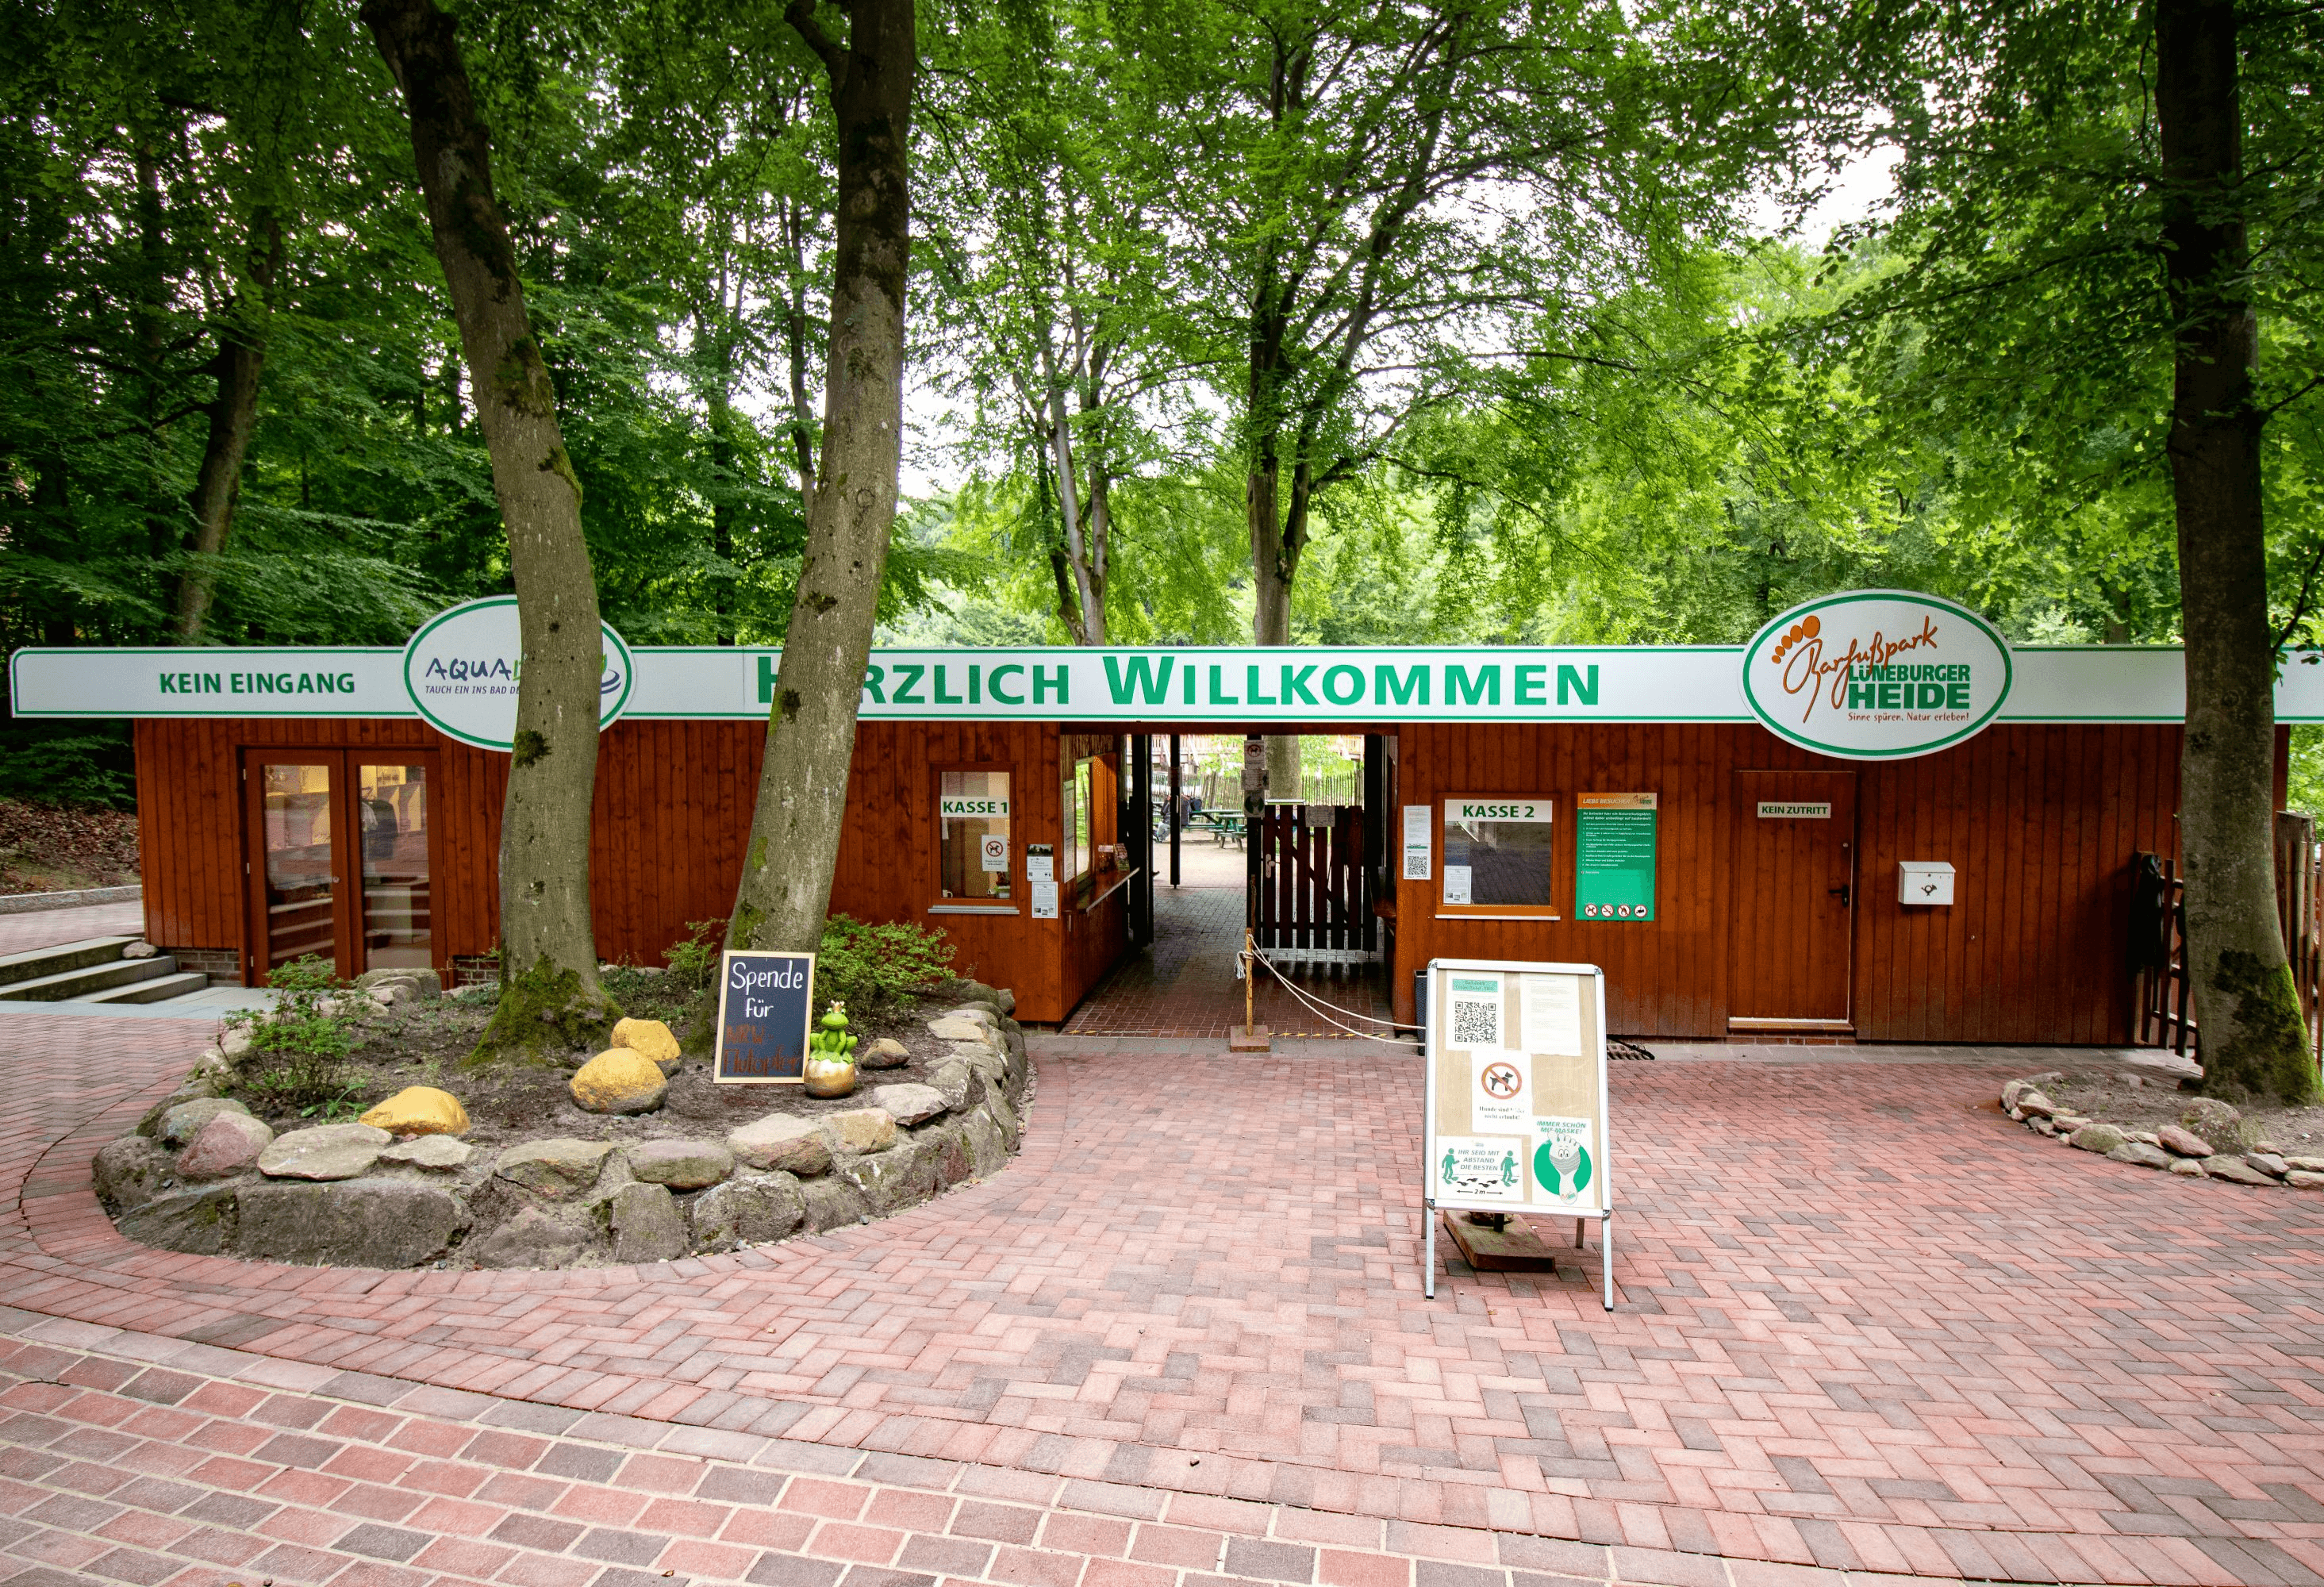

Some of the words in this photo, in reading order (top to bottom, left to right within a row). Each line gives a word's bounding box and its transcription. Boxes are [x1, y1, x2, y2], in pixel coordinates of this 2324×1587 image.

[425, 658, 521, 681] AQUA
[1783, 615, 1938, 723] Barfußpark
[1848, 664, 1971, 682] LÜNEBURGER
[159, 673, 221, 694] KEIN
[230, 673, 355, 694] EINGANG
[490, 686, 507, 694] BAD
[758, 656, 1068, 705] HRZLICH
[1102, 655, 1600, 707] WILLKOMMEN
[1847, 683, 1971, 709] HEIDE
[1848, 712, 1870, 721] Sinne
[1907, 712, 1930, 721] Natur
[1934, 712, 1969, 721] erleben!
[943, 801, 996, 813] KASSE
[1001, 801, 1008, 813] 1
[1462, 805, 1519, 818] KASSE
[1524, 805, 1535, 818] 2
[1761, 805, 1784, 814] KEIN
[1787, 806, 1828, 815] ZUTRITT
[731, 959, 804, 996] Spende
